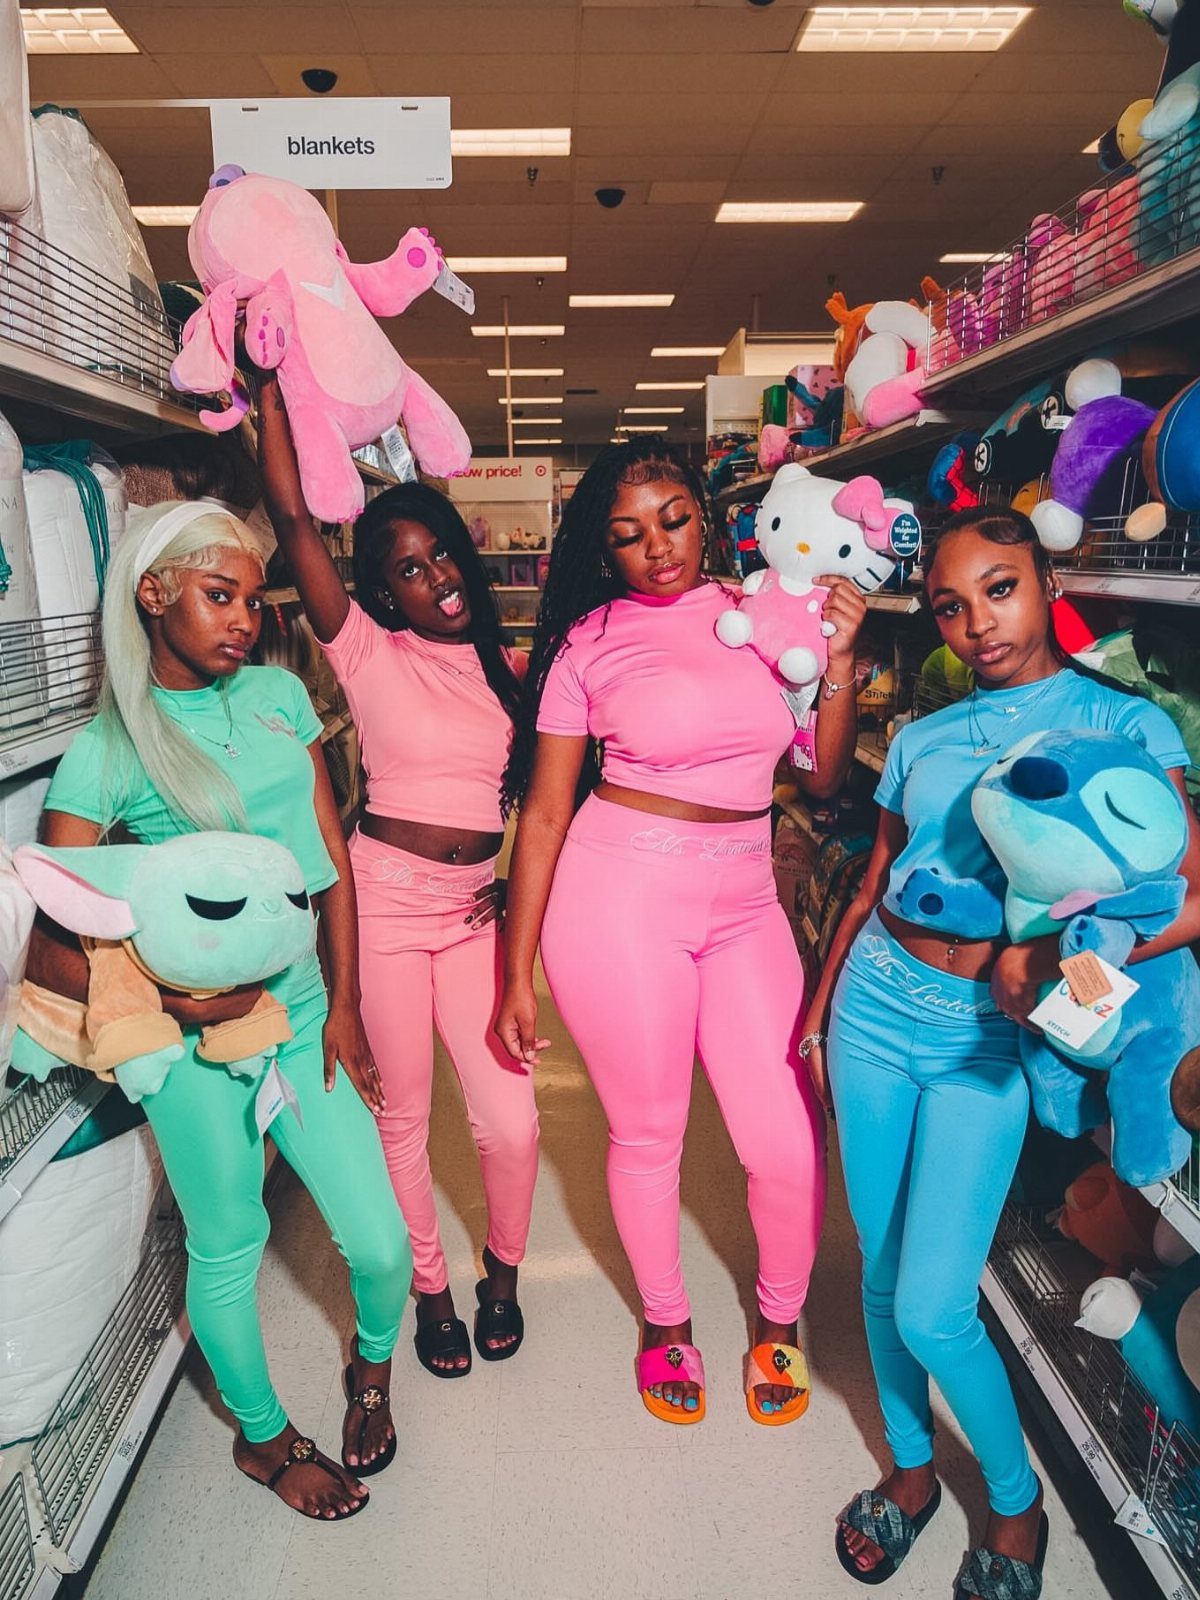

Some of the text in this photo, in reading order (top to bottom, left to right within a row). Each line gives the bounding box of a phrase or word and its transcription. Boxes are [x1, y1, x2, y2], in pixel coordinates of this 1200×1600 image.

[287, 136, 375, 155] blankets
[486, 465, 522, 480] price!
[1045, 1020, 1071, 1038] STITCH
[1081, 1441, 1096, 1460] 29.99
